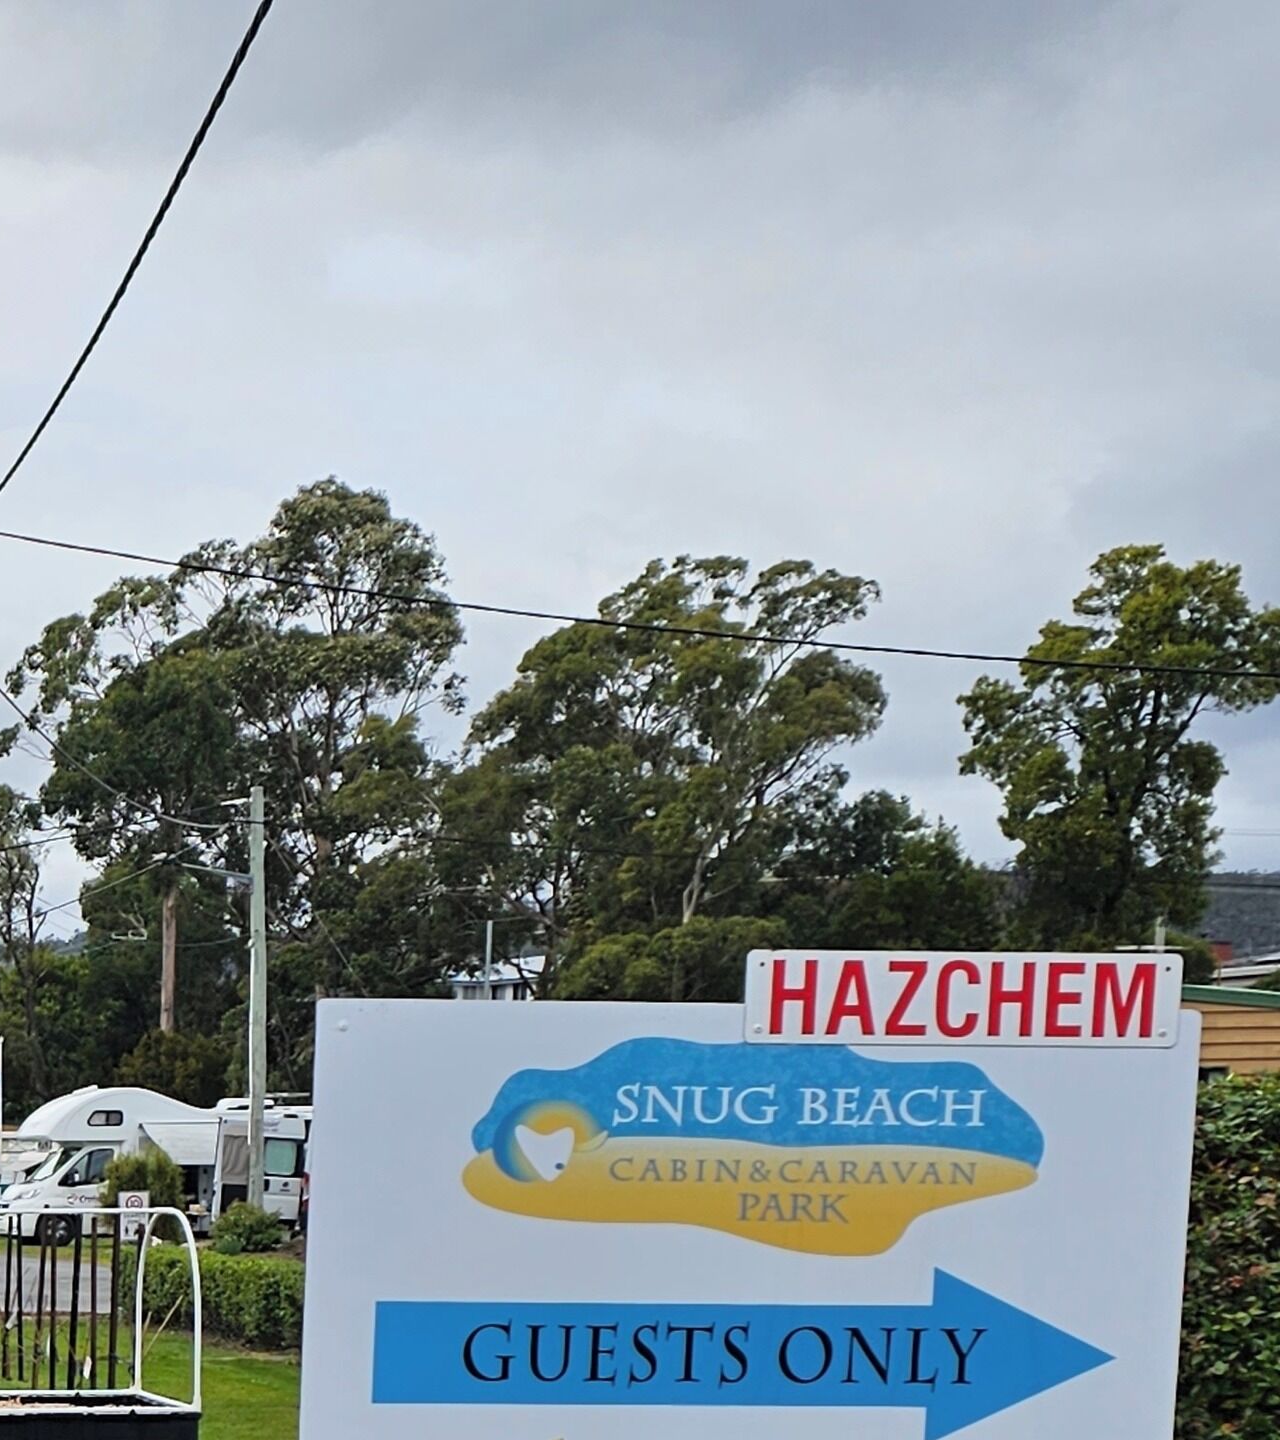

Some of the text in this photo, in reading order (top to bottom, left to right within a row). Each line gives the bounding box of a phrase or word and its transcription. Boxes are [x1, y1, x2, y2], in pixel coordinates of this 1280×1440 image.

[768, 959, 1158, 1038] HAZCHEM
[611, 1081, 987, 1128] SNUG BEACH
[736, 1192, 850, 1224] PARK
[462, 1320, 990, 1393] GUESTS ONLY
